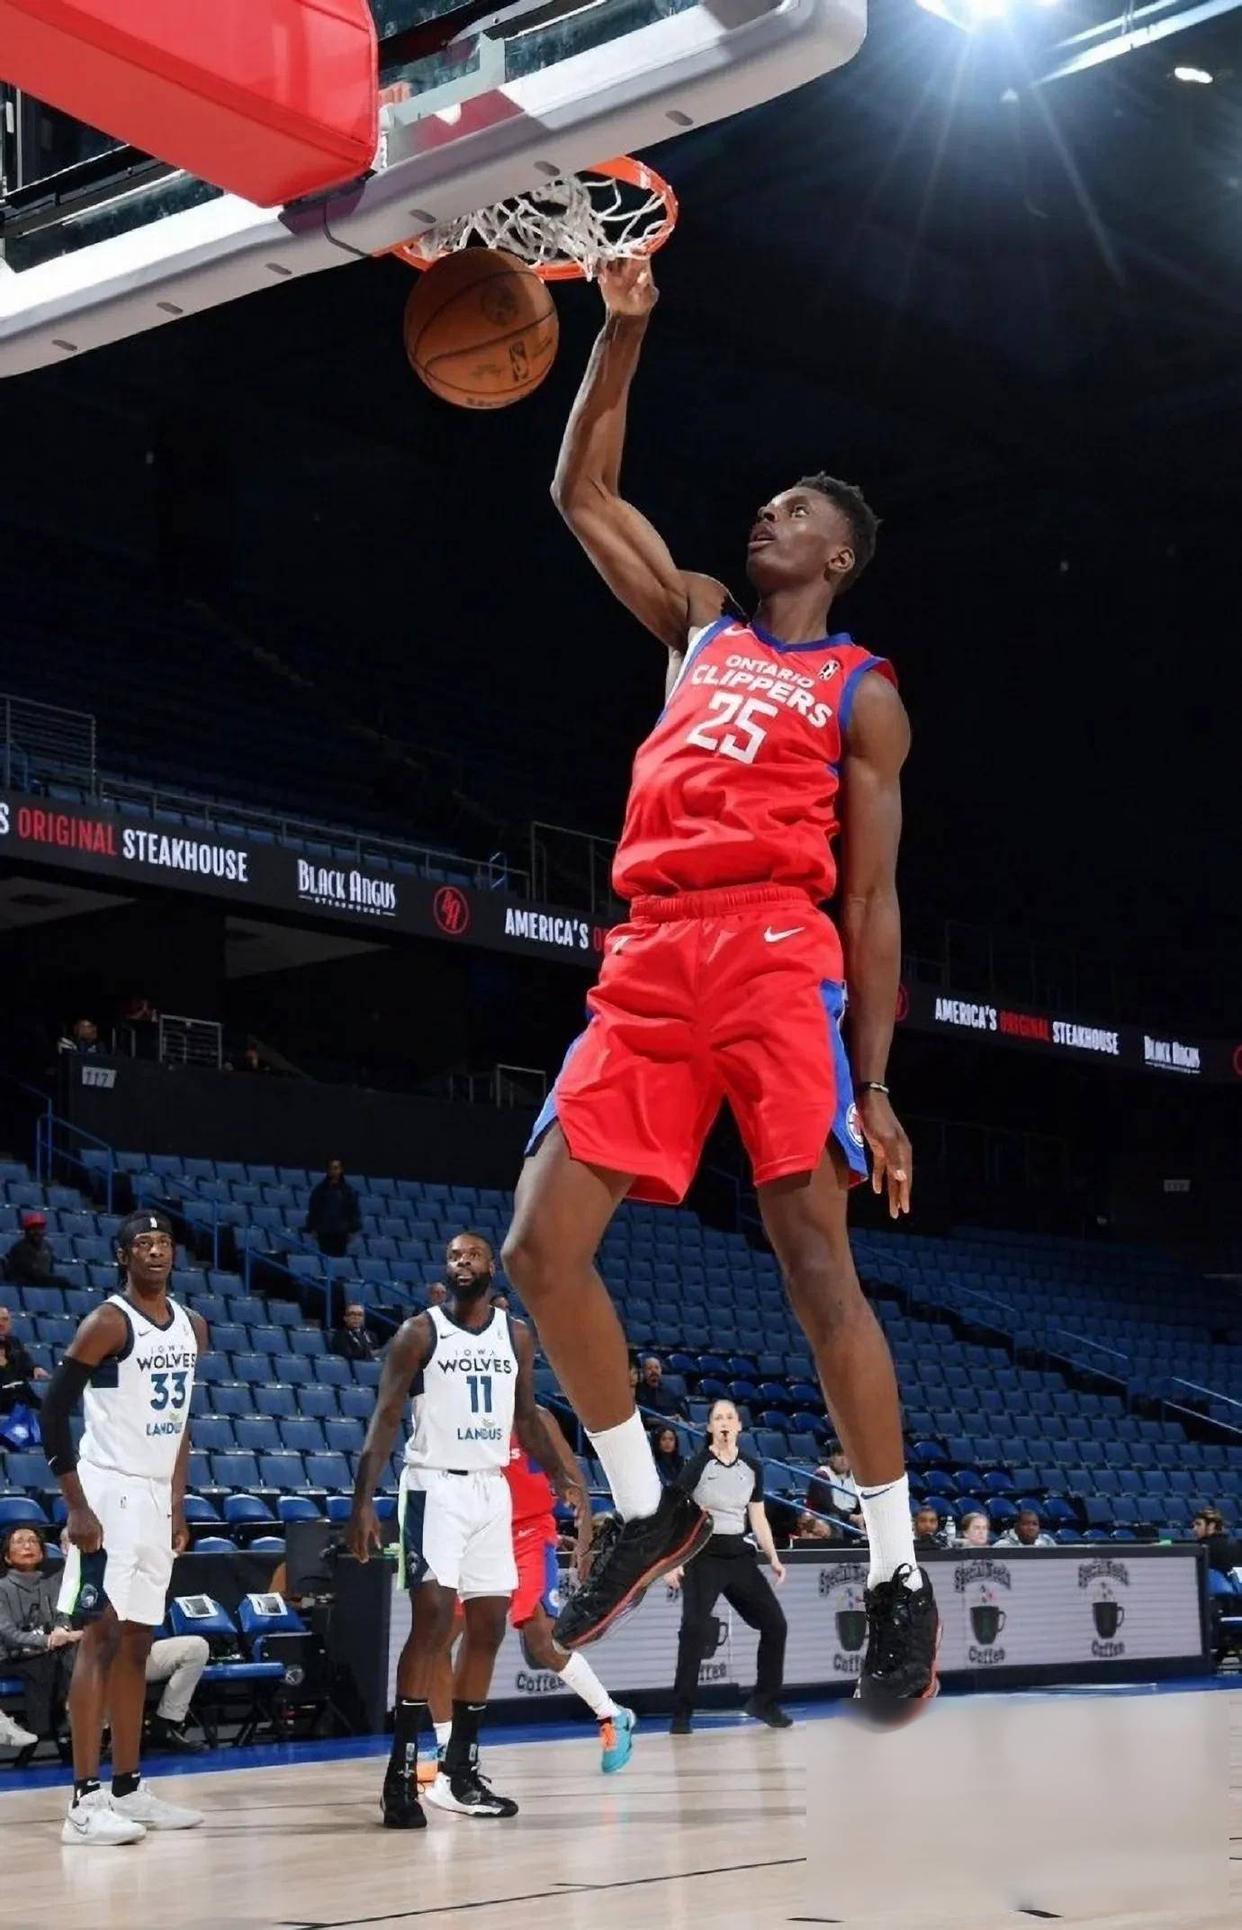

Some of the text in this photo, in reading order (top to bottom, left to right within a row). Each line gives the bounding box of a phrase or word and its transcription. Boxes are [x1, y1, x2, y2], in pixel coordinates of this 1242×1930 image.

[726, 654, 815, 688] ONTARIO
[691, 664, 833, 728] CLIPPERS
[687, 691, 778, 765] 25
[18, 807, 117, 855] ORIGINAL
[122, 828, 248, 882] STEAKHOUSE
[504, 907, 588, 949] AMERICA'S
[935, 998, 997, 1031] AMERICA'S
[1052, 1021, 1119, 1055] STEAKHOUSE
[136, 1353, 196, 1372] WOLVES
[437, 1358, 512, 1374] WOLVES
[150, 1371, 188, 1410] 33
[466, 1375, 493, 1413] 11
